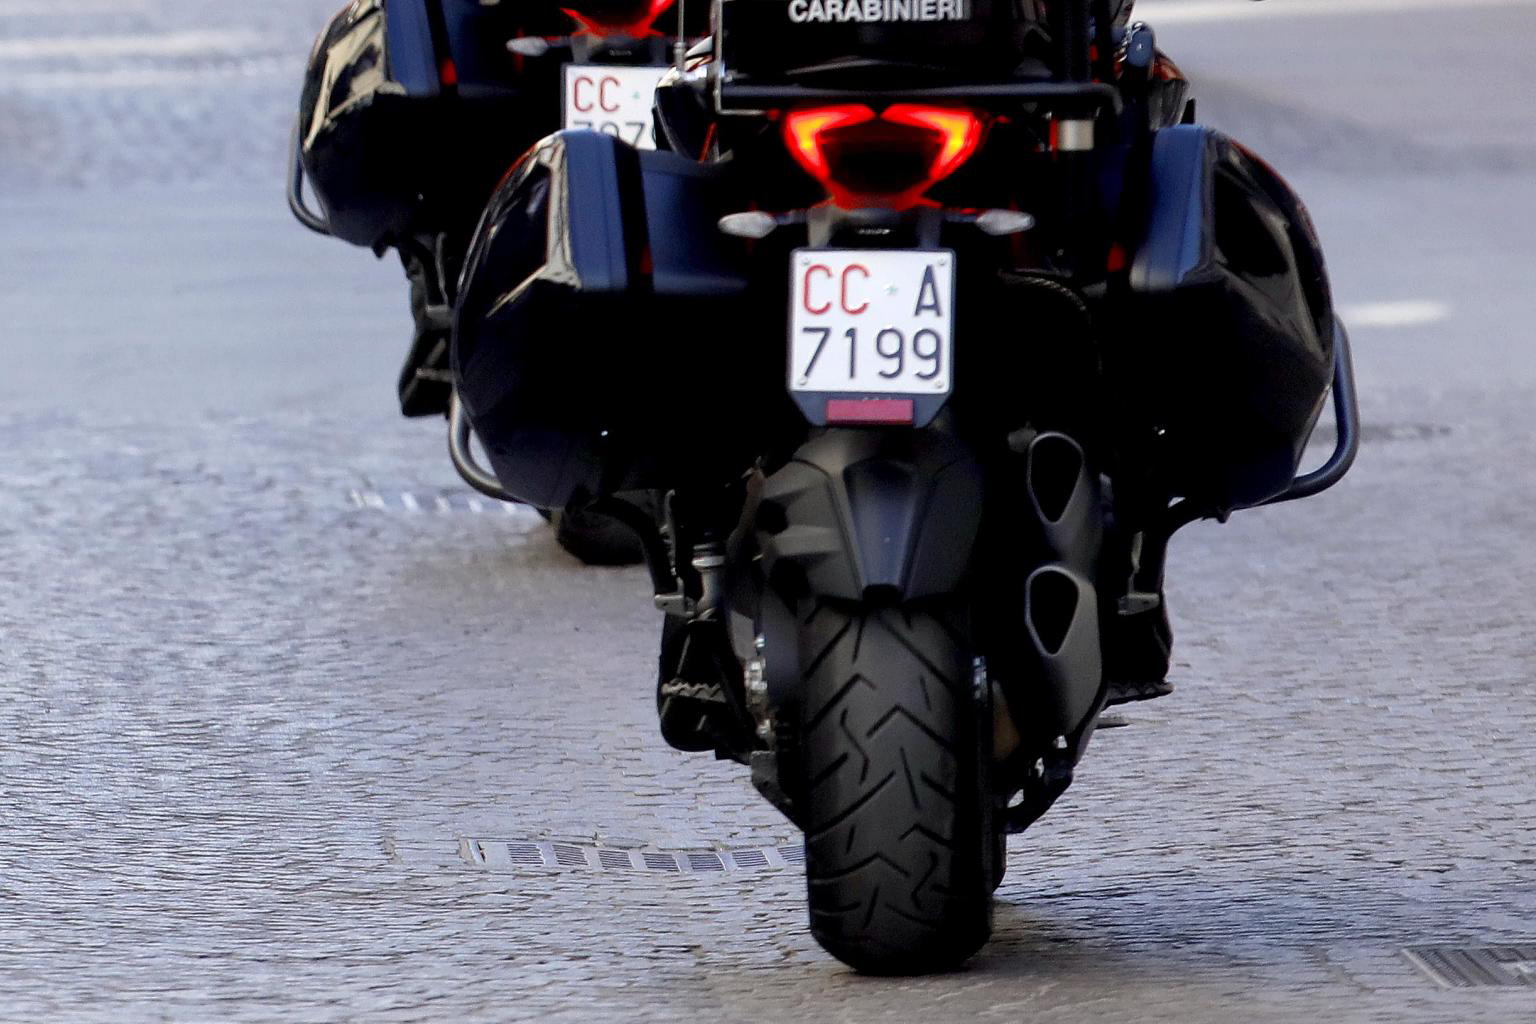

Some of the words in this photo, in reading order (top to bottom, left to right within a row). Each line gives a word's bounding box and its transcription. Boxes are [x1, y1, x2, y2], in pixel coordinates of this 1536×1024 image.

[574, 76, 620, 112] CC
[803, 264, 870, 315] CC
[914, 264, 943, 317] A
[802, 327, 942, 380] 7199
